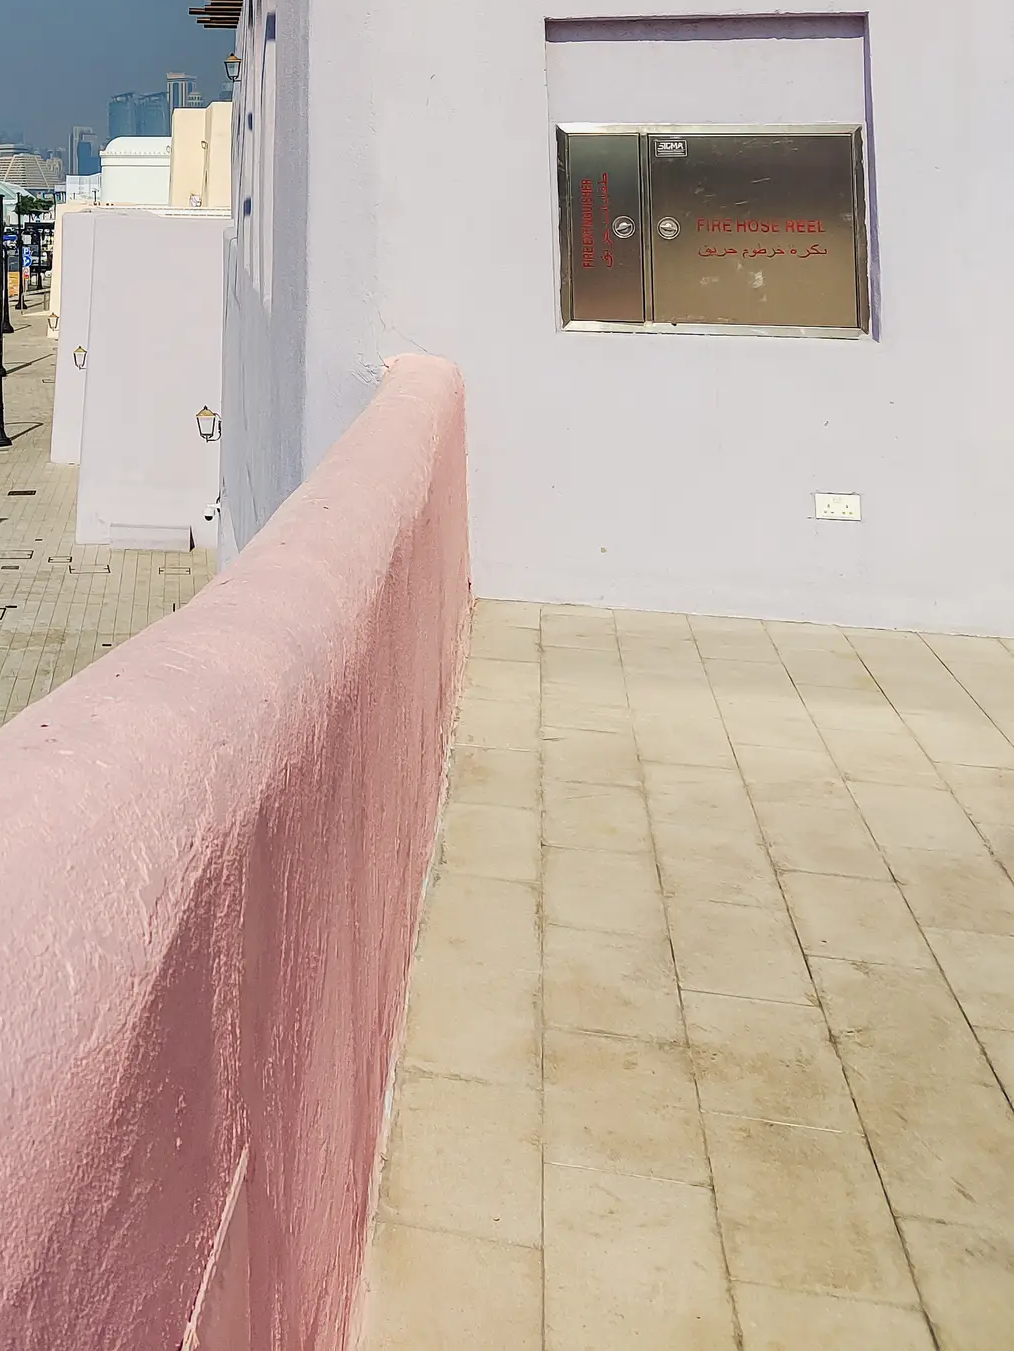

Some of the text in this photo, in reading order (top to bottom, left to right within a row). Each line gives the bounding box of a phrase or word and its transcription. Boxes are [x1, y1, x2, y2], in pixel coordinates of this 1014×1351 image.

[657, 142, 684, 150] SIGMA
[579, 178, 595, 269] FIRE EXTINGUISHER
[696, 218, 827, 233] FIRE HOSE REEL
[698, 244, 738, 258] حريق
[742, 242, 785, 258] خرطوم
